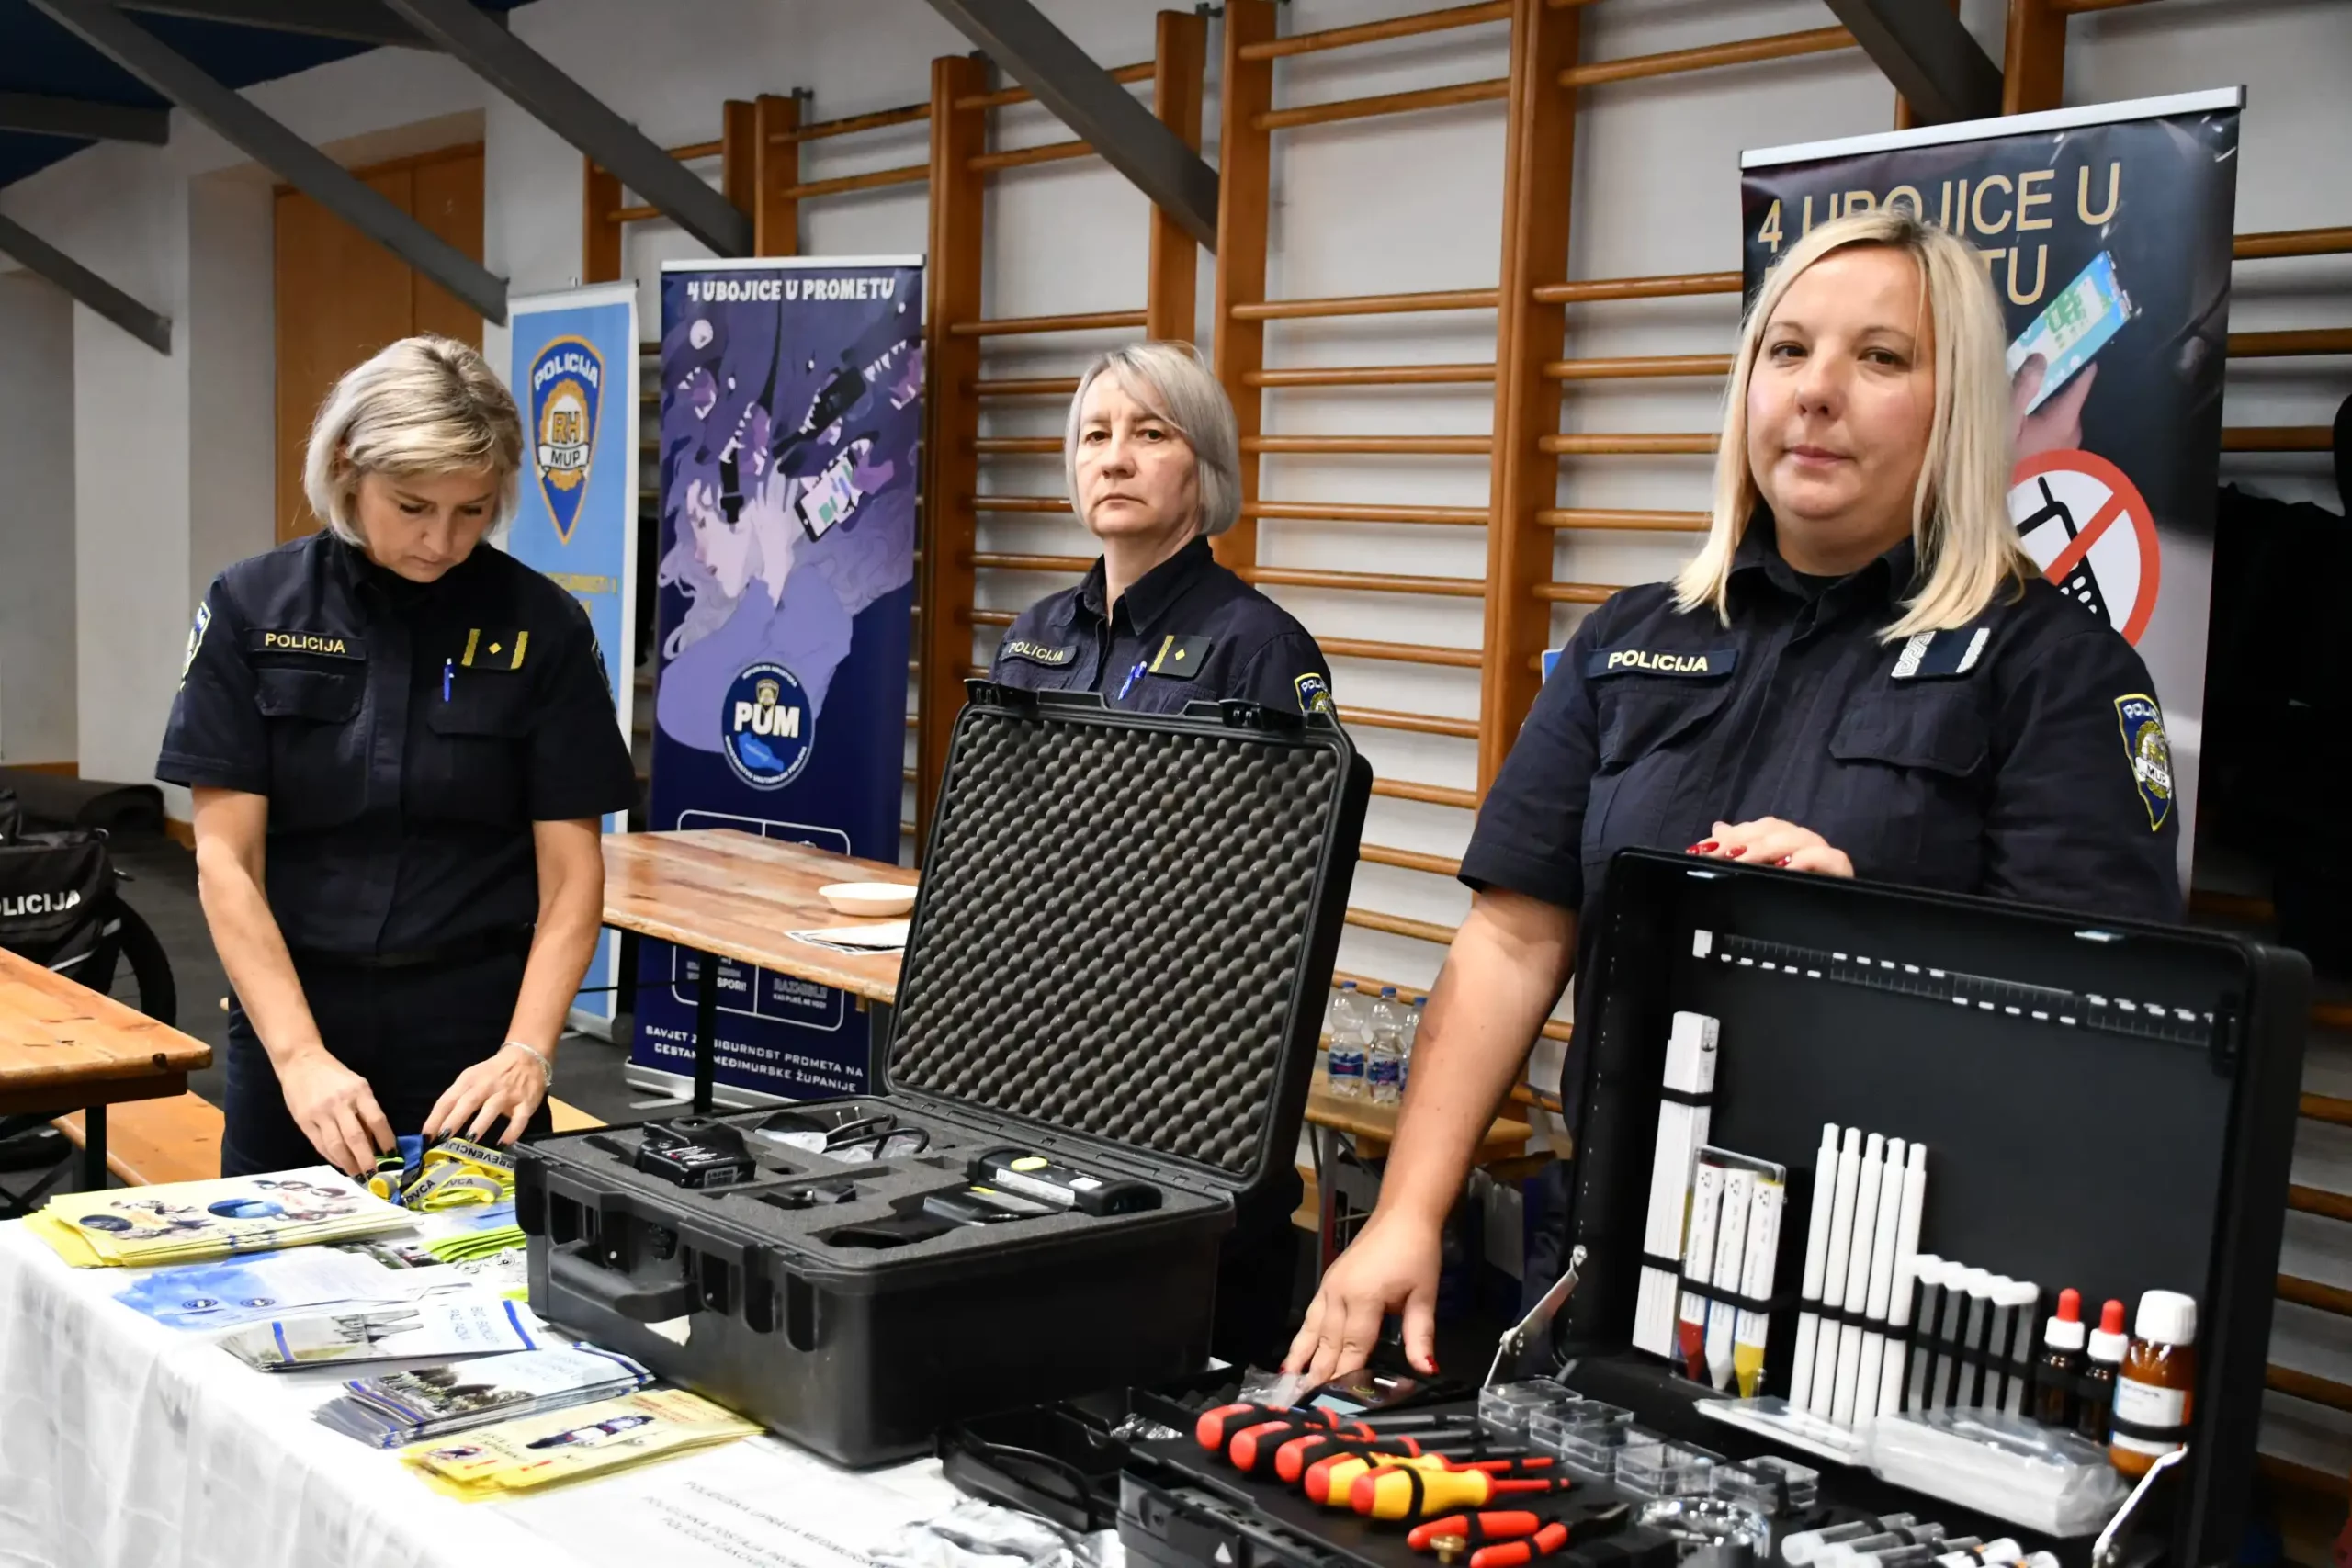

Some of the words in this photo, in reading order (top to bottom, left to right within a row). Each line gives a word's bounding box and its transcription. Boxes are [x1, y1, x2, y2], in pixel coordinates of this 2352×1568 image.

[1758, 199, 1783, 253] 4
[2076, 162, 2120, 226] U
[687, 281, 699, 302] 4
[702, 279, 781, 302] UBOJICE
[785, 279, 799, 301] U
[802, 277, 896, 301] PROMETU
[534, 352, 598, 392] POLICIJA
[553, 411, 581, 444] RH
[551, 449, 581, 467] MUP
[265, 632, 346, 654] POLICIJA
[1008, 641, 1064, 662] POLICIJA
[1608, 649, 1708, 672] POLICIJA
[734, 701, 800, 739] PUM
[2146, 764, 2167, 784] MUP
[0, 889, 81, 917] LICIJA
[645, 1025, 688, 1043] SAVJET
[784, 1053, 842, 1073] PROMETA
[846, 1066, 864, 1077] NA
[654, 1043, 696, 1059] CESTA
[796, 1070, 856, 1093] ŽUPANIJE
